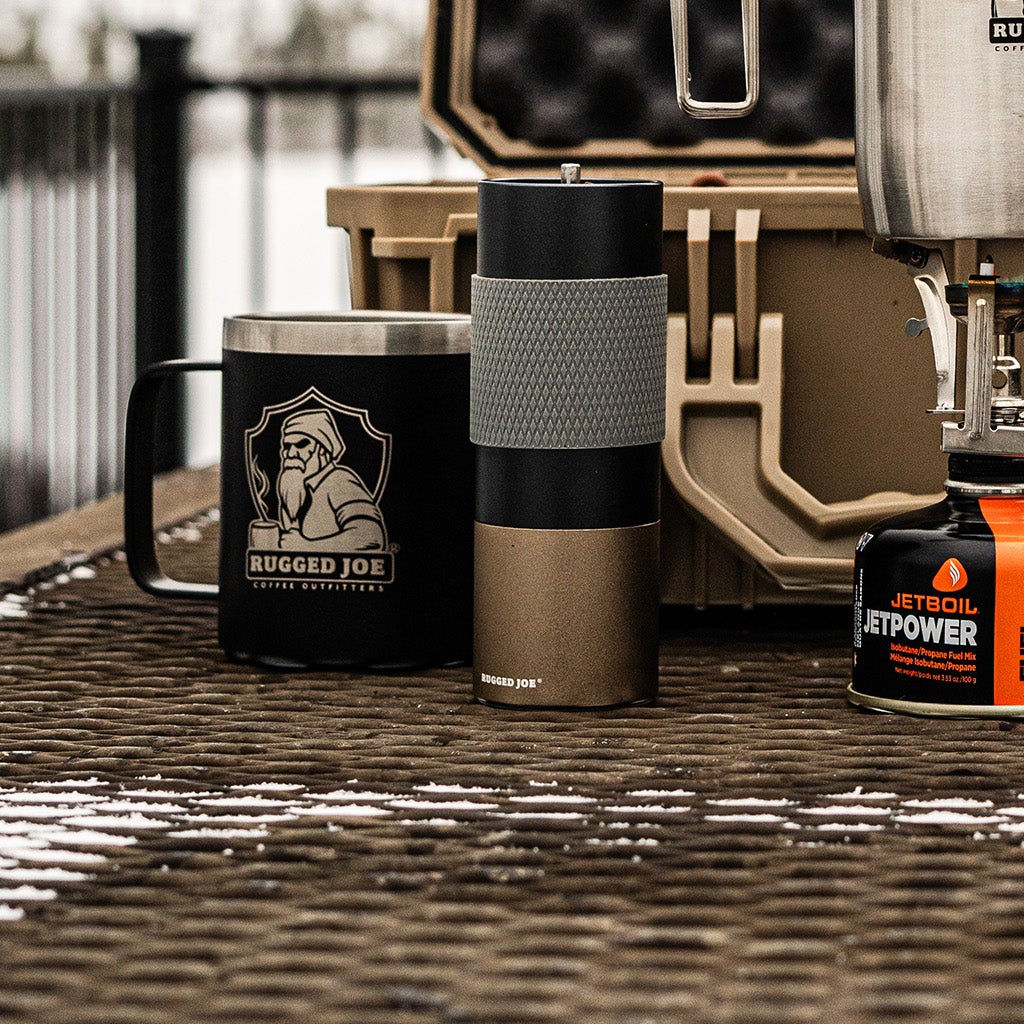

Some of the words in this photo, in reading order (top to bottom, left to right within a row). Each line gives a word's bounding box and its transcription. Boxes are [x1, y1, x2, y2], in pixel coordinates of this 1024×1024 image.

[250, 555, 336, 574] RUGGED
[340, 557, 385, 578] JOE
[302, 582, 384, 592] OUTFITTERS
[890, 593, 978, 614] JETBOIL
[863, 608, 978, 646] JETPOWER
[890, 642, 948, 659] Isobutane/Propane
[948, 651, 963, 660] Fuel
[964, 652, 977, 661] Mix
[914, 657, 977, 672] Isobutane/Propane
[481, 673, 514, 687] RUGGED
[515, 678, 537, 689] JOE
